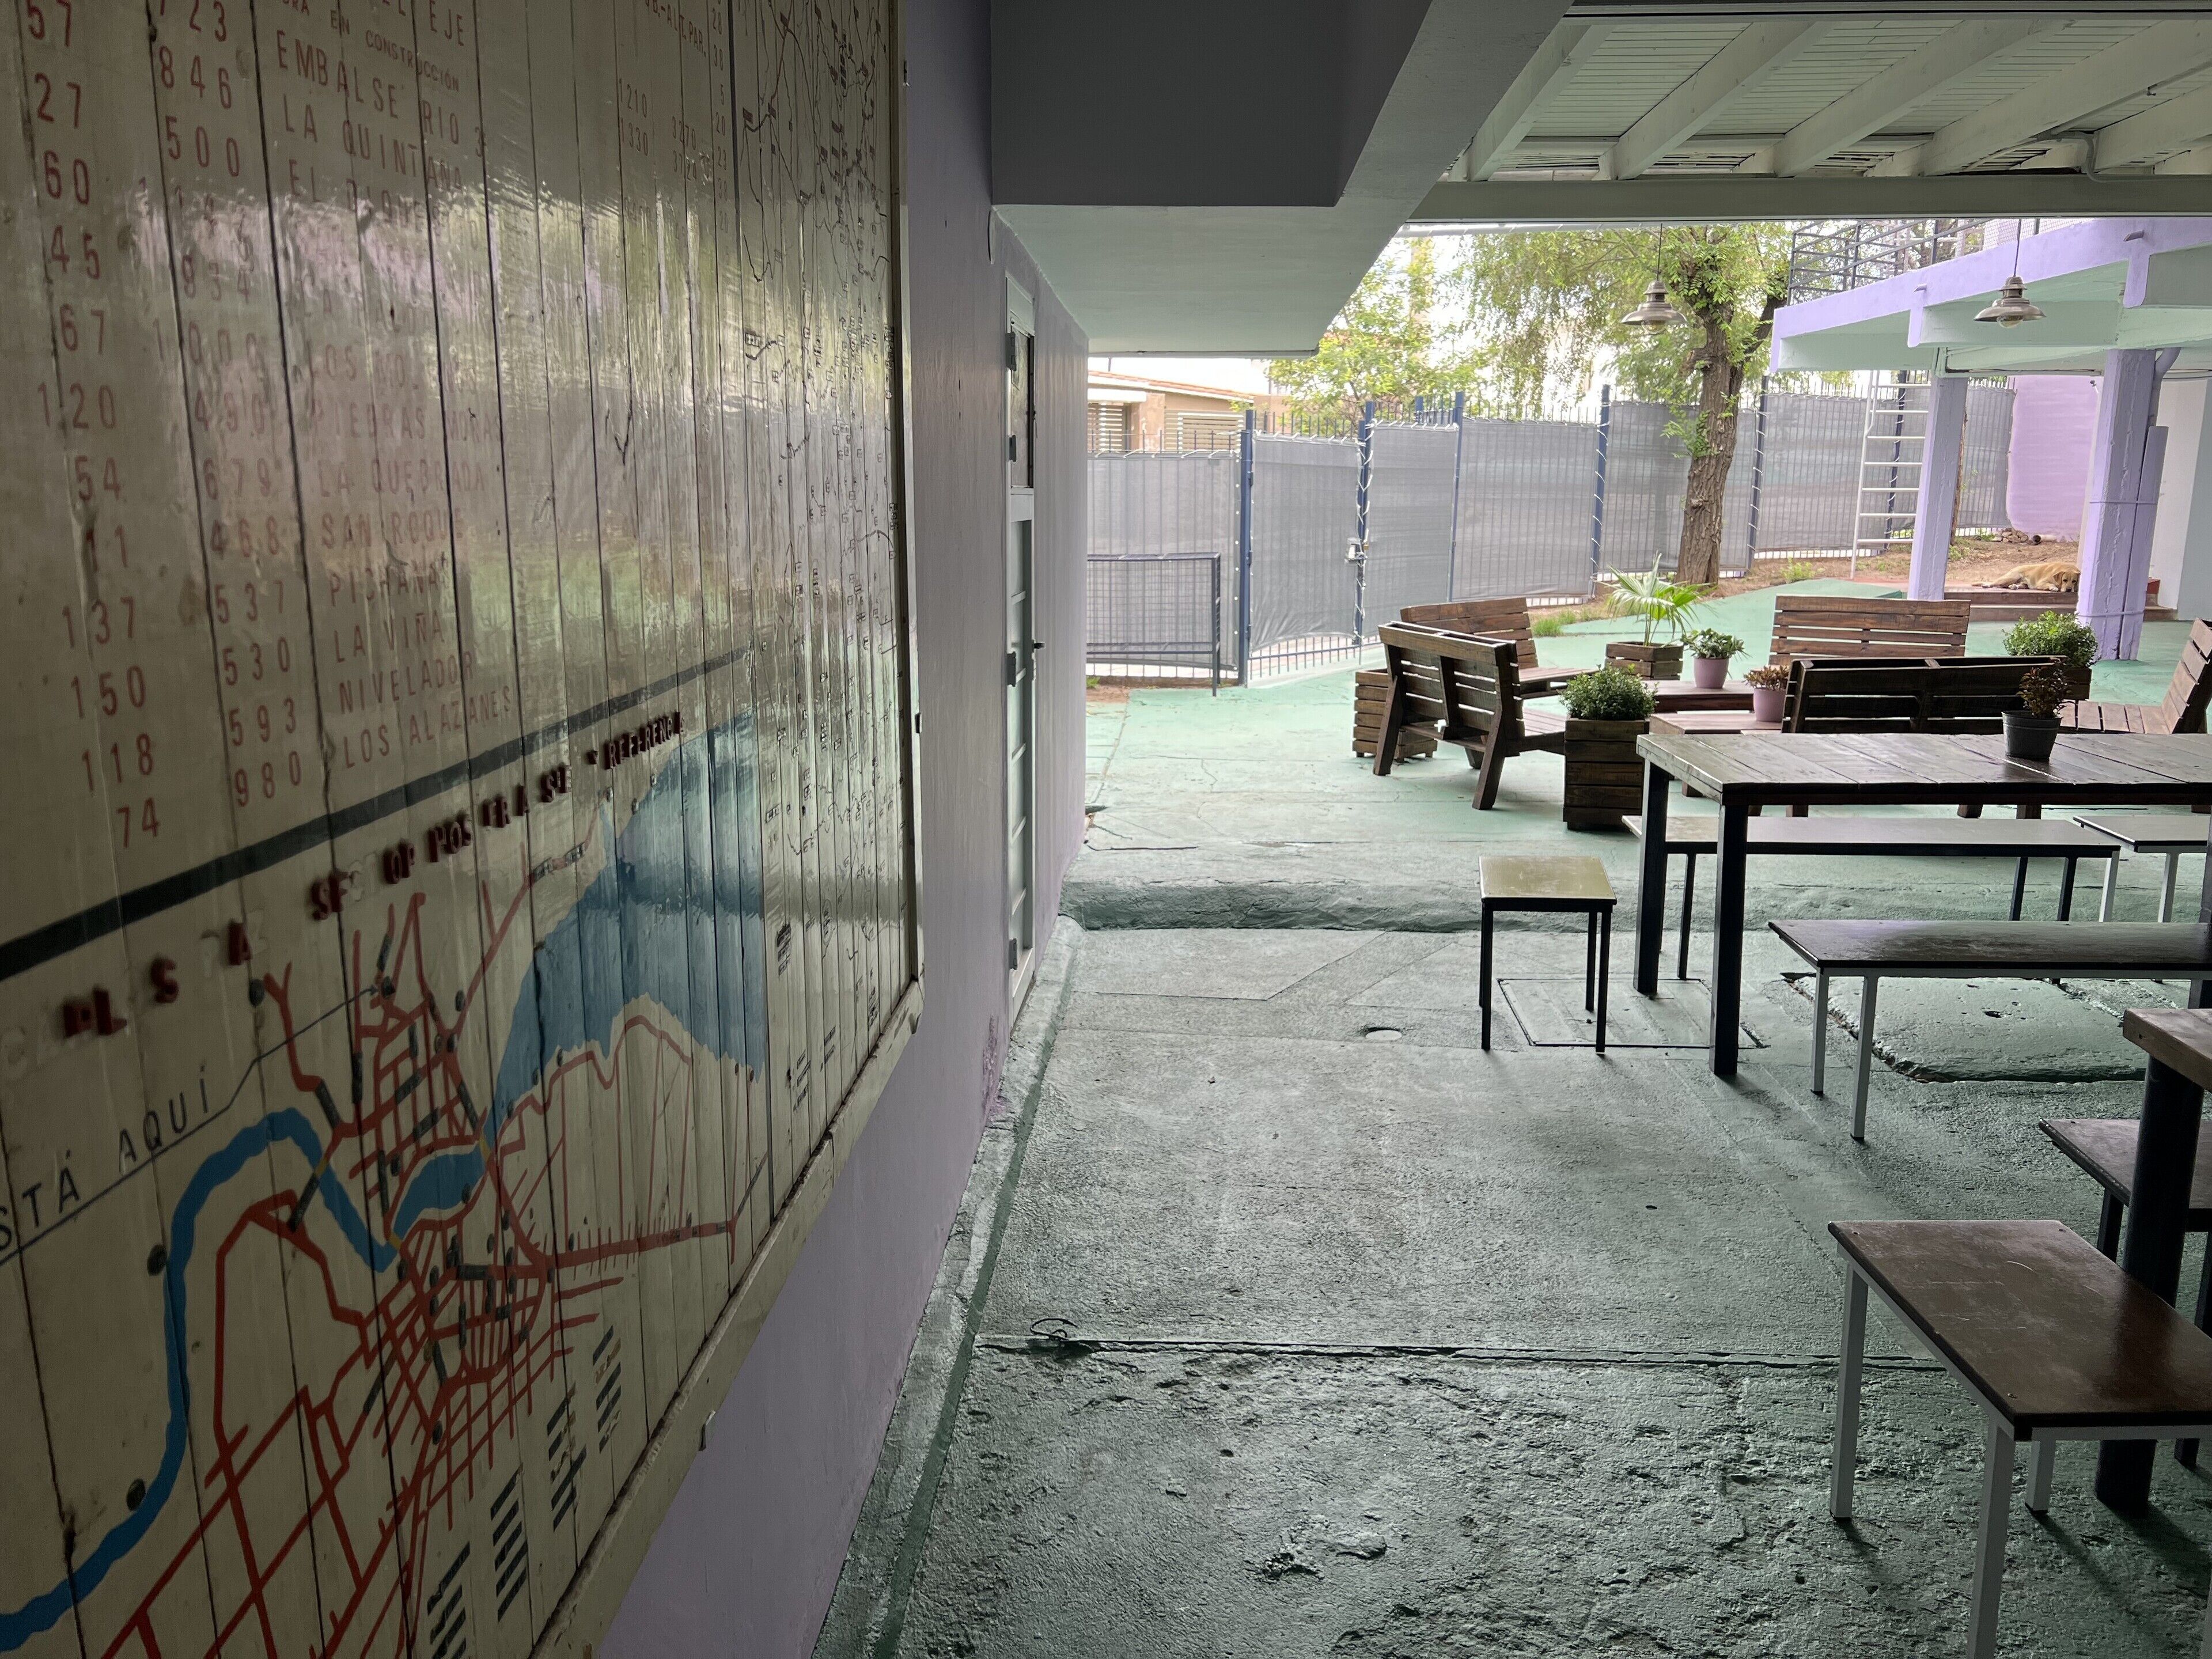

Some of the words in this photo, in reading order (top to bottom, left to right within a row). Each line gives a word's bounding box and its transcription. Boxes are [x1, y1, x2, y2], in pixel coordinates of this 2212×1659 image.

[26, 0, 72, 47] 57
[35, 72, 81, 129] 27
[158, 45, 232, 109] 846
[276, 30, 398, 119] EMBALSE
[421, 100, 459, 145] RIO
[619, 78, 647, 118] 1210
[166, 116, 240, 177] 500
[283, 93, 317, 143] LA
[342, 119, 461, 191] QUINTANA
[620, 118, 649, 156] 1330
[43, 149, 90, 206] 60
[51, 225, 100, 281] 45
[59, 303, 105, 355] 67
[37, 381, 116, 430] 120
[74, 455, 121, 501] 54
[210, 517, 279, 558] 468
[321, 512, 372, 550] SAN
[62, 596, 135, 649] 137
[215, 579, 283, 624] 537
[222, 637, 290, 685] 530
[334, 624, 367, 663] LA
[70, 665, 146, 719] 150
[339, 650, 473, 714] NIVELADOR
[230, 698, 297, 747] 593
[343, 724, 390, 768] LOS
[410, 685, 511, 746] ALAZANES
[81, 733, 154, 790] 118
[234, 751, 301, 806] 980
[118, 797, 159, 849] 74
